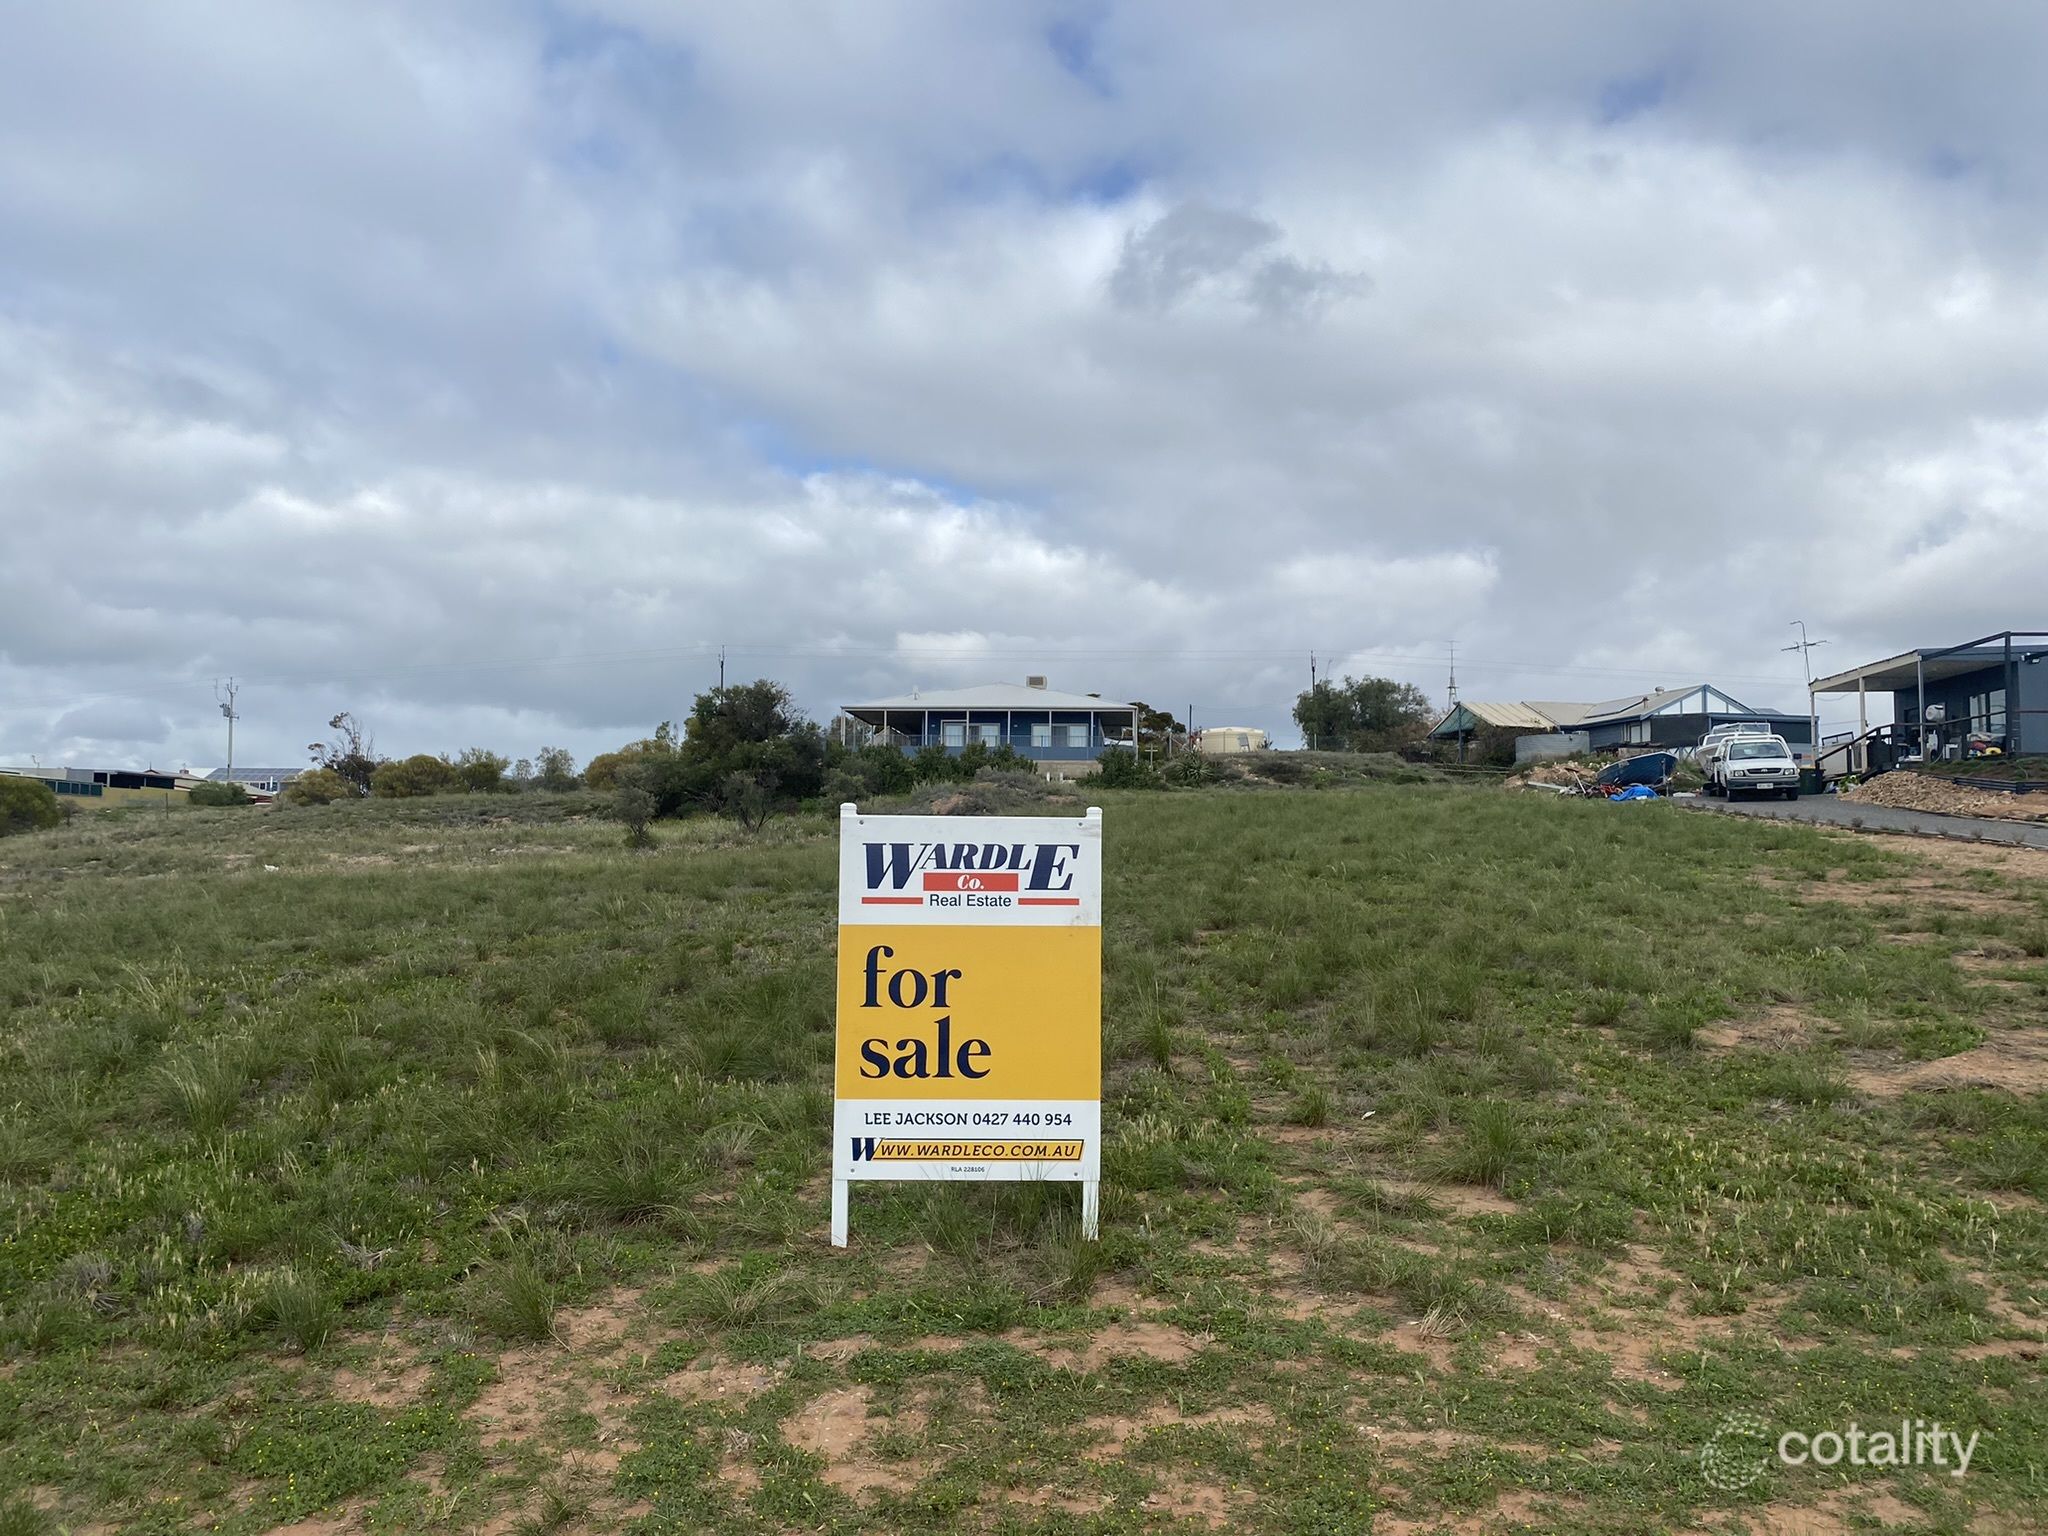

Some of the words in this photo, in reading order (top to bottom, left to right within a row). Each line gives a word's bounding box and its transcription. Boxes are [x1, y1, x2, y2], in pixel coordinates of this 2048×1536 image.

[862, 843, 1080, 891] WARDLE
[957, 874, 984, 890] Co.
[929, 894, 961, 907] Real
[967, 894, 1012, 907] Estate
[859, 945, 963, 1008] for
[859, 1015, 992, 1079] sale
[864, 1112, 891, 1125] LEE
[895, 1112, 968, 1126] JACKSON
[972, 1113, 1008, 1126] 0427
[1012, 1113, 1040, 1126] 440
[1045, 1113, 1072, 1126] 954
